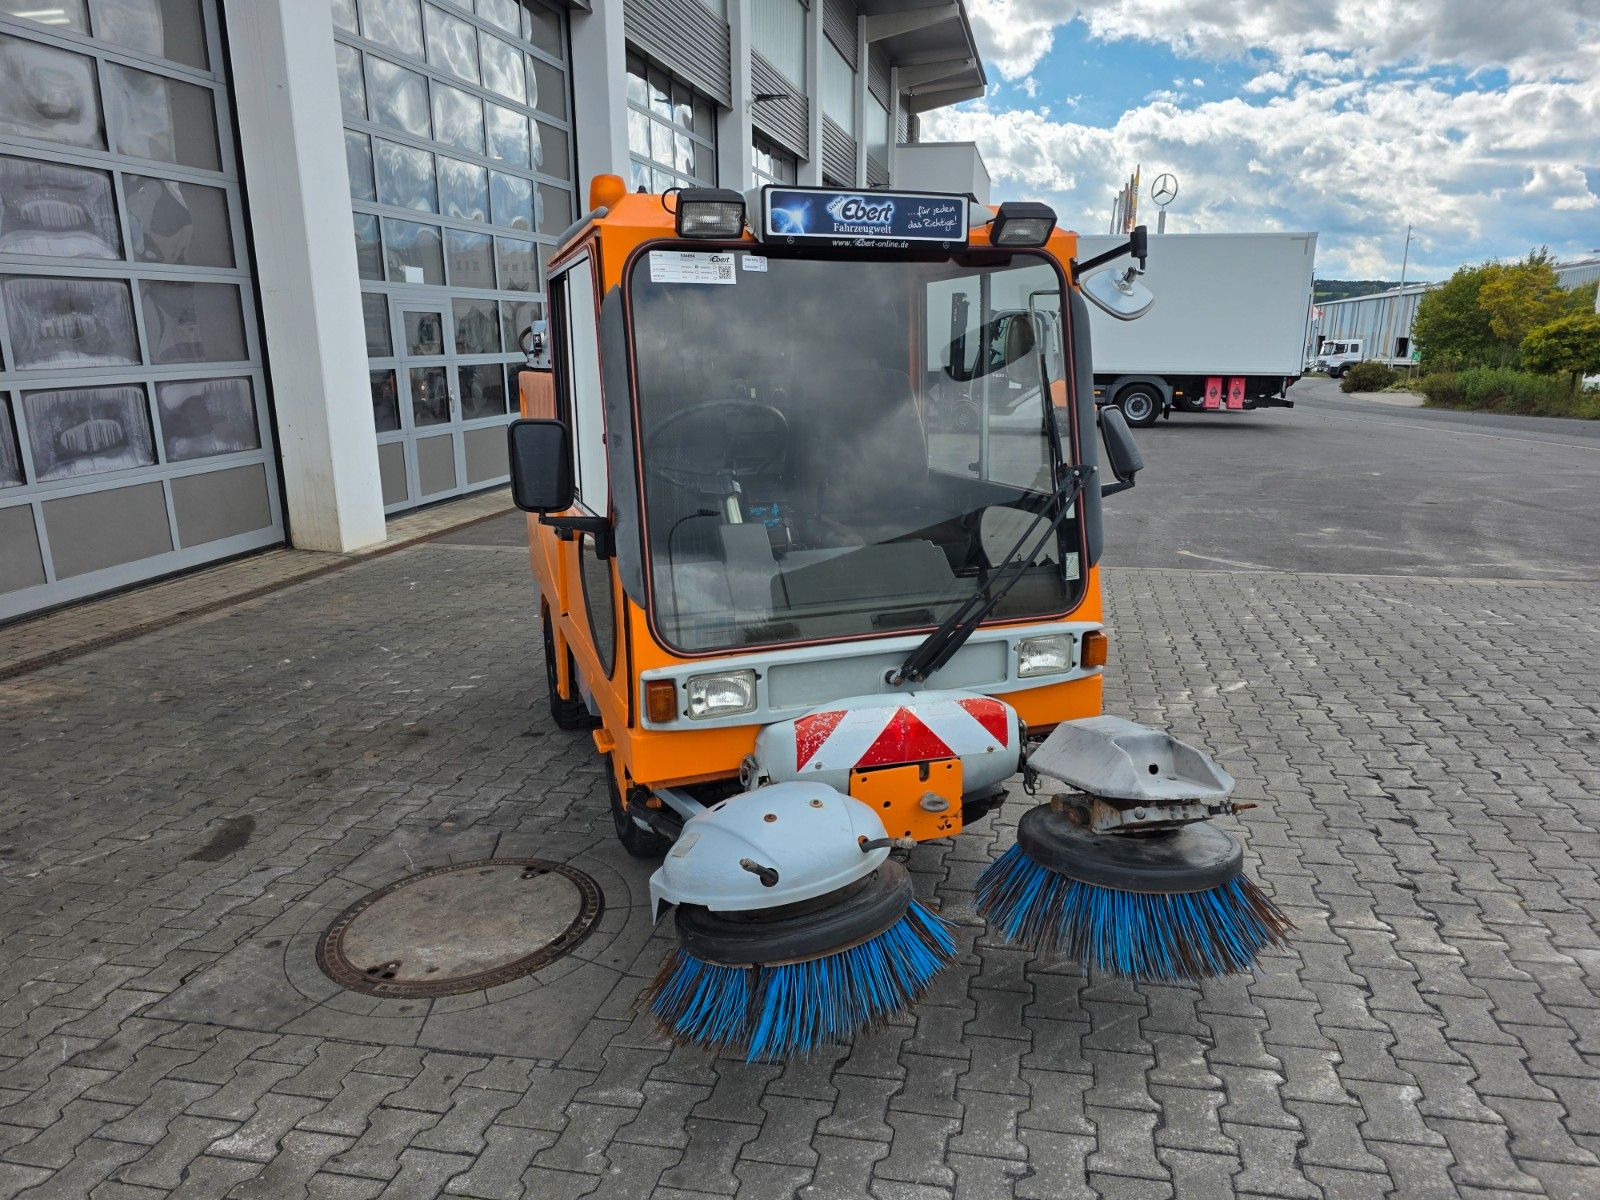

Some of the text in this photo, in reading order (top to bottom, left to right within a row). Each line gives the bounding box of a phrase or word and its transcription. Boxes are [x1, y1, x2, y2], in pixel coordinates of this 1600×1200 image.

[841, 198, 893, 222] Ebert
[933, 204, 955, 215] jeden
[833, 222, 892, 235] Fahrzeugwelt
[908, 220, 922, 229] das
[711, 255, 730, 263] Ebert
